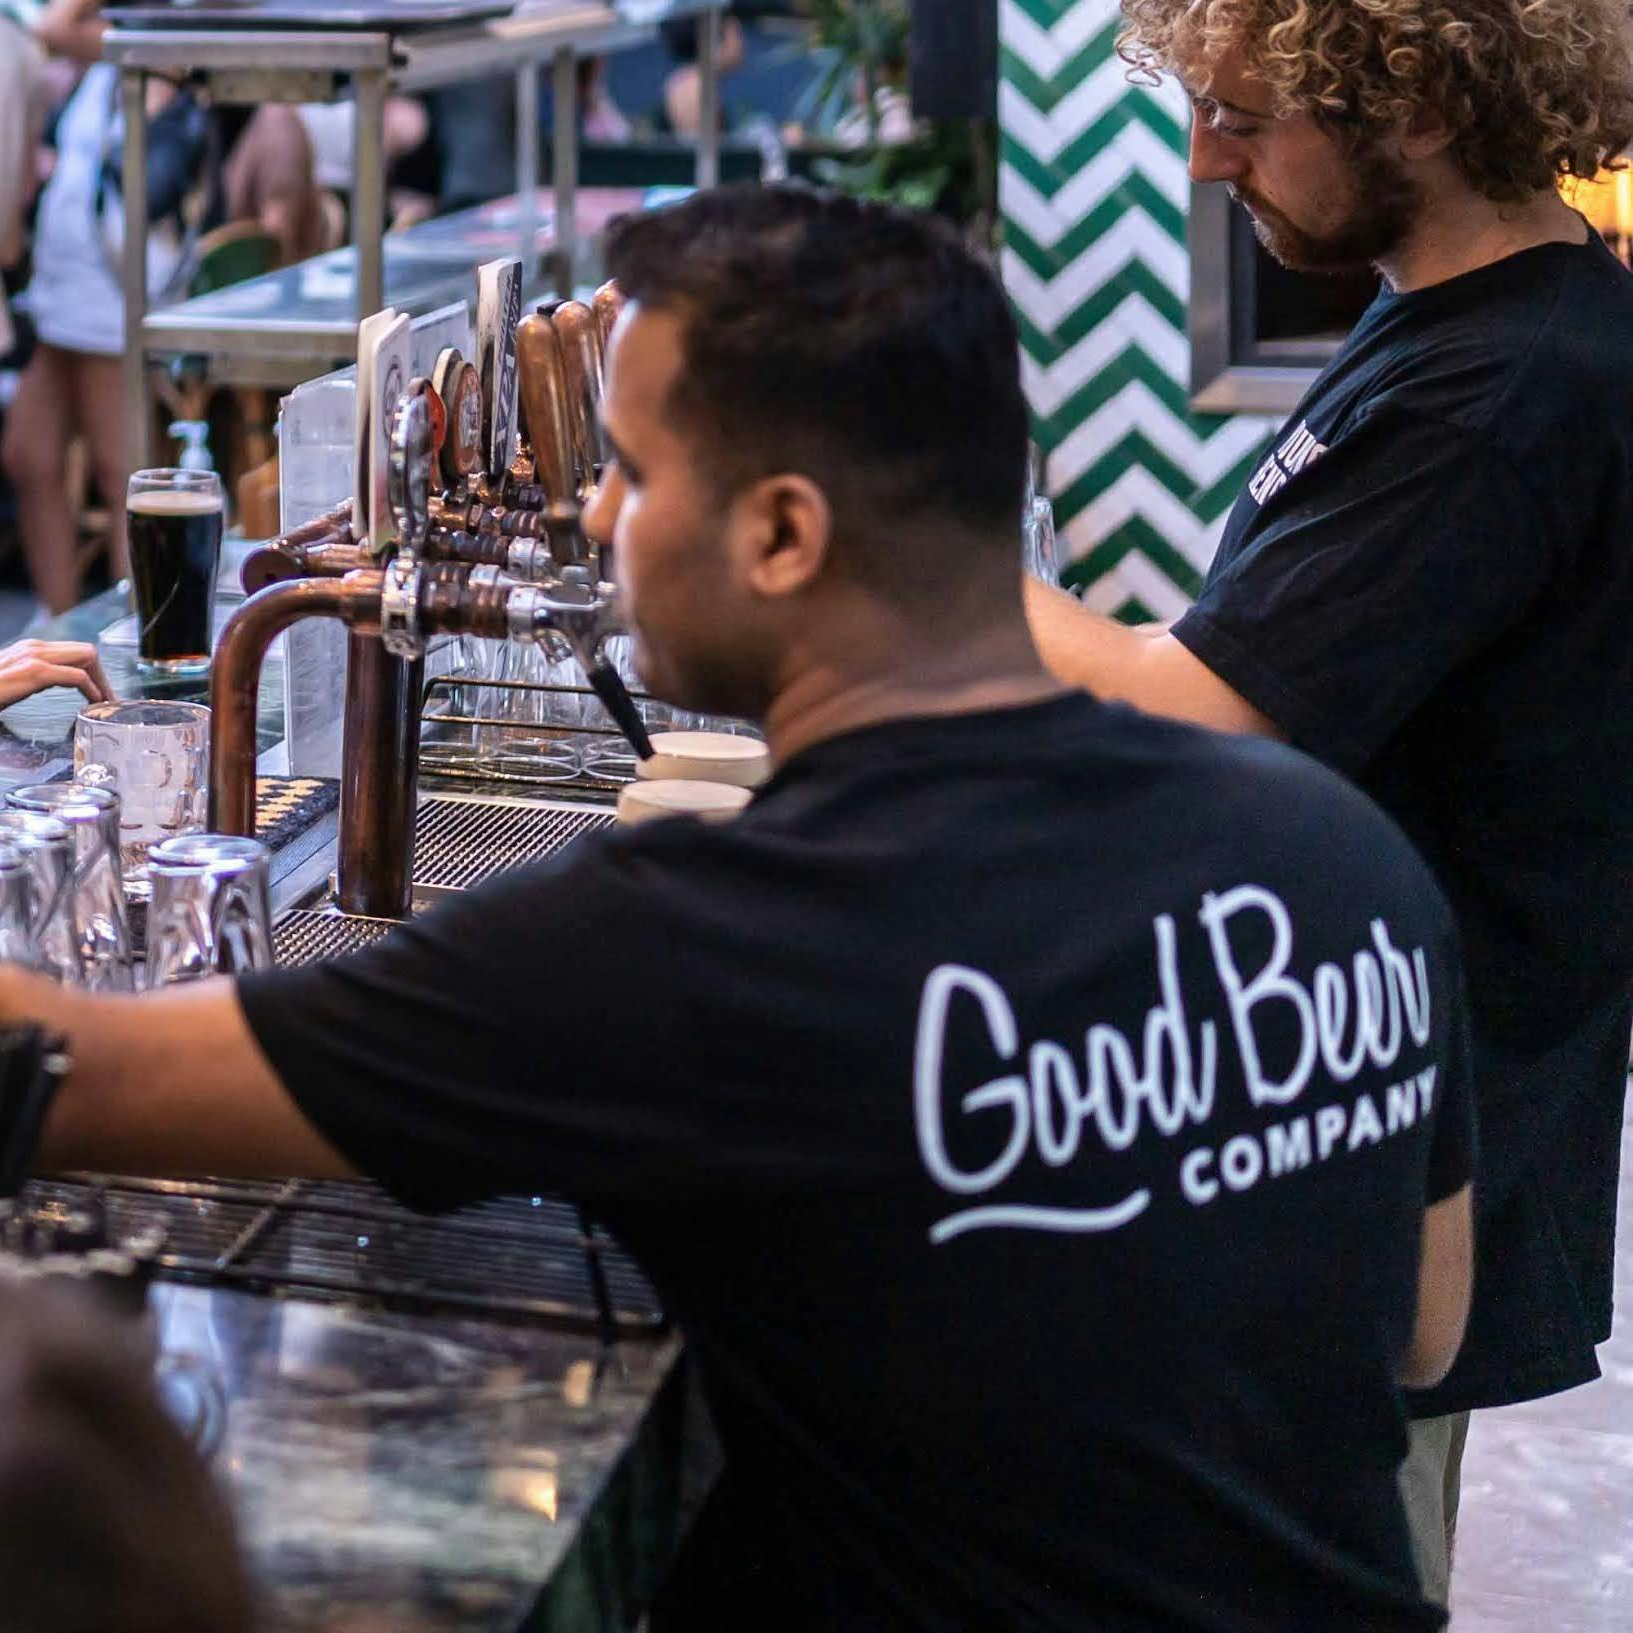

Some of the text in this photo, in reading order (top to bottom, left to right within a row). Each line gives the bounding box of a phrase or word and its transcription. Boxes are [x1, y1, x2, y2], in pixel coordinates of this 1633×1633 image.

[914, 884, 1430, 1194] Good Beer
[1179, 1066, 1436, 1206] COMPANY
